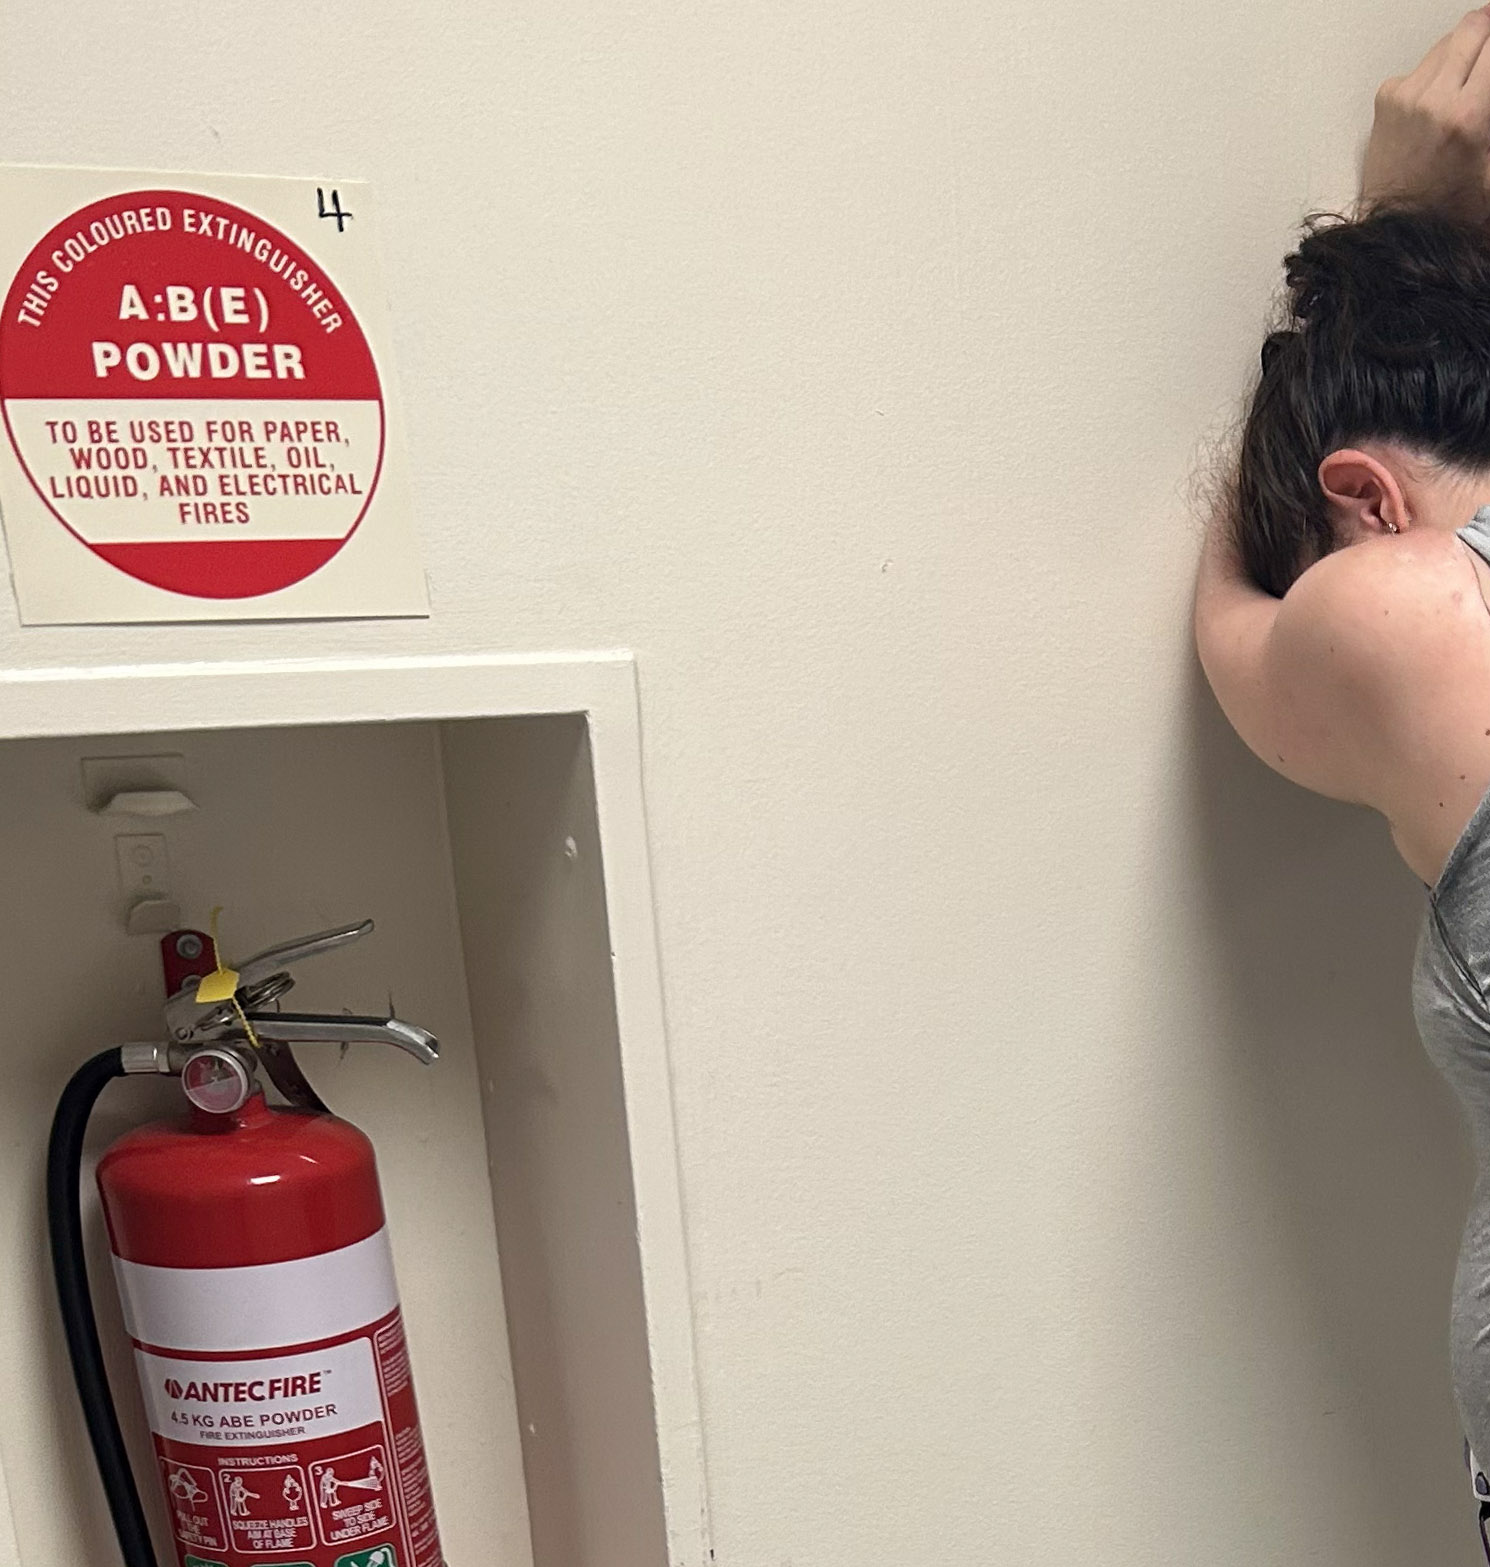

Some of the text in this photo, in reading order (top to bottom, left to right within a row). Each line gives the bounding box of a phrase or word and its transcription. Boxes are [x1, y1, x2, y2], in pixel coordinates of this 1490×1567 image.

[317, 187, 353, 232] 4
[18, 206, 343, 334] THIS COLOURED EXTINGUISHER
[118, 284, 270, 333] A:B(E)
[91, 341, 306, 381] POWDER
[45, 420, 350, 447] TO BE USED FOR PAPER,
[69, 447, 336, 473] WOOD, TEXTILE, OIL,
[50, 473, 363, 501] LIQUID, AND ELECTRICAL
[179, 502, 250, 525] FIRES
[171, 1403, 338, 1428] 4.5 KG ABE POWDER
[200, 1426, 306, 1441] FIRE EXTINGUISHER
[218, 1453, 299, 1467] INSTRUCTIONS
[314, 1466, 323, 1476] 3
[222, 1473, 232, 1483] 2
[330, 1525, 361, 1540] UNDER
